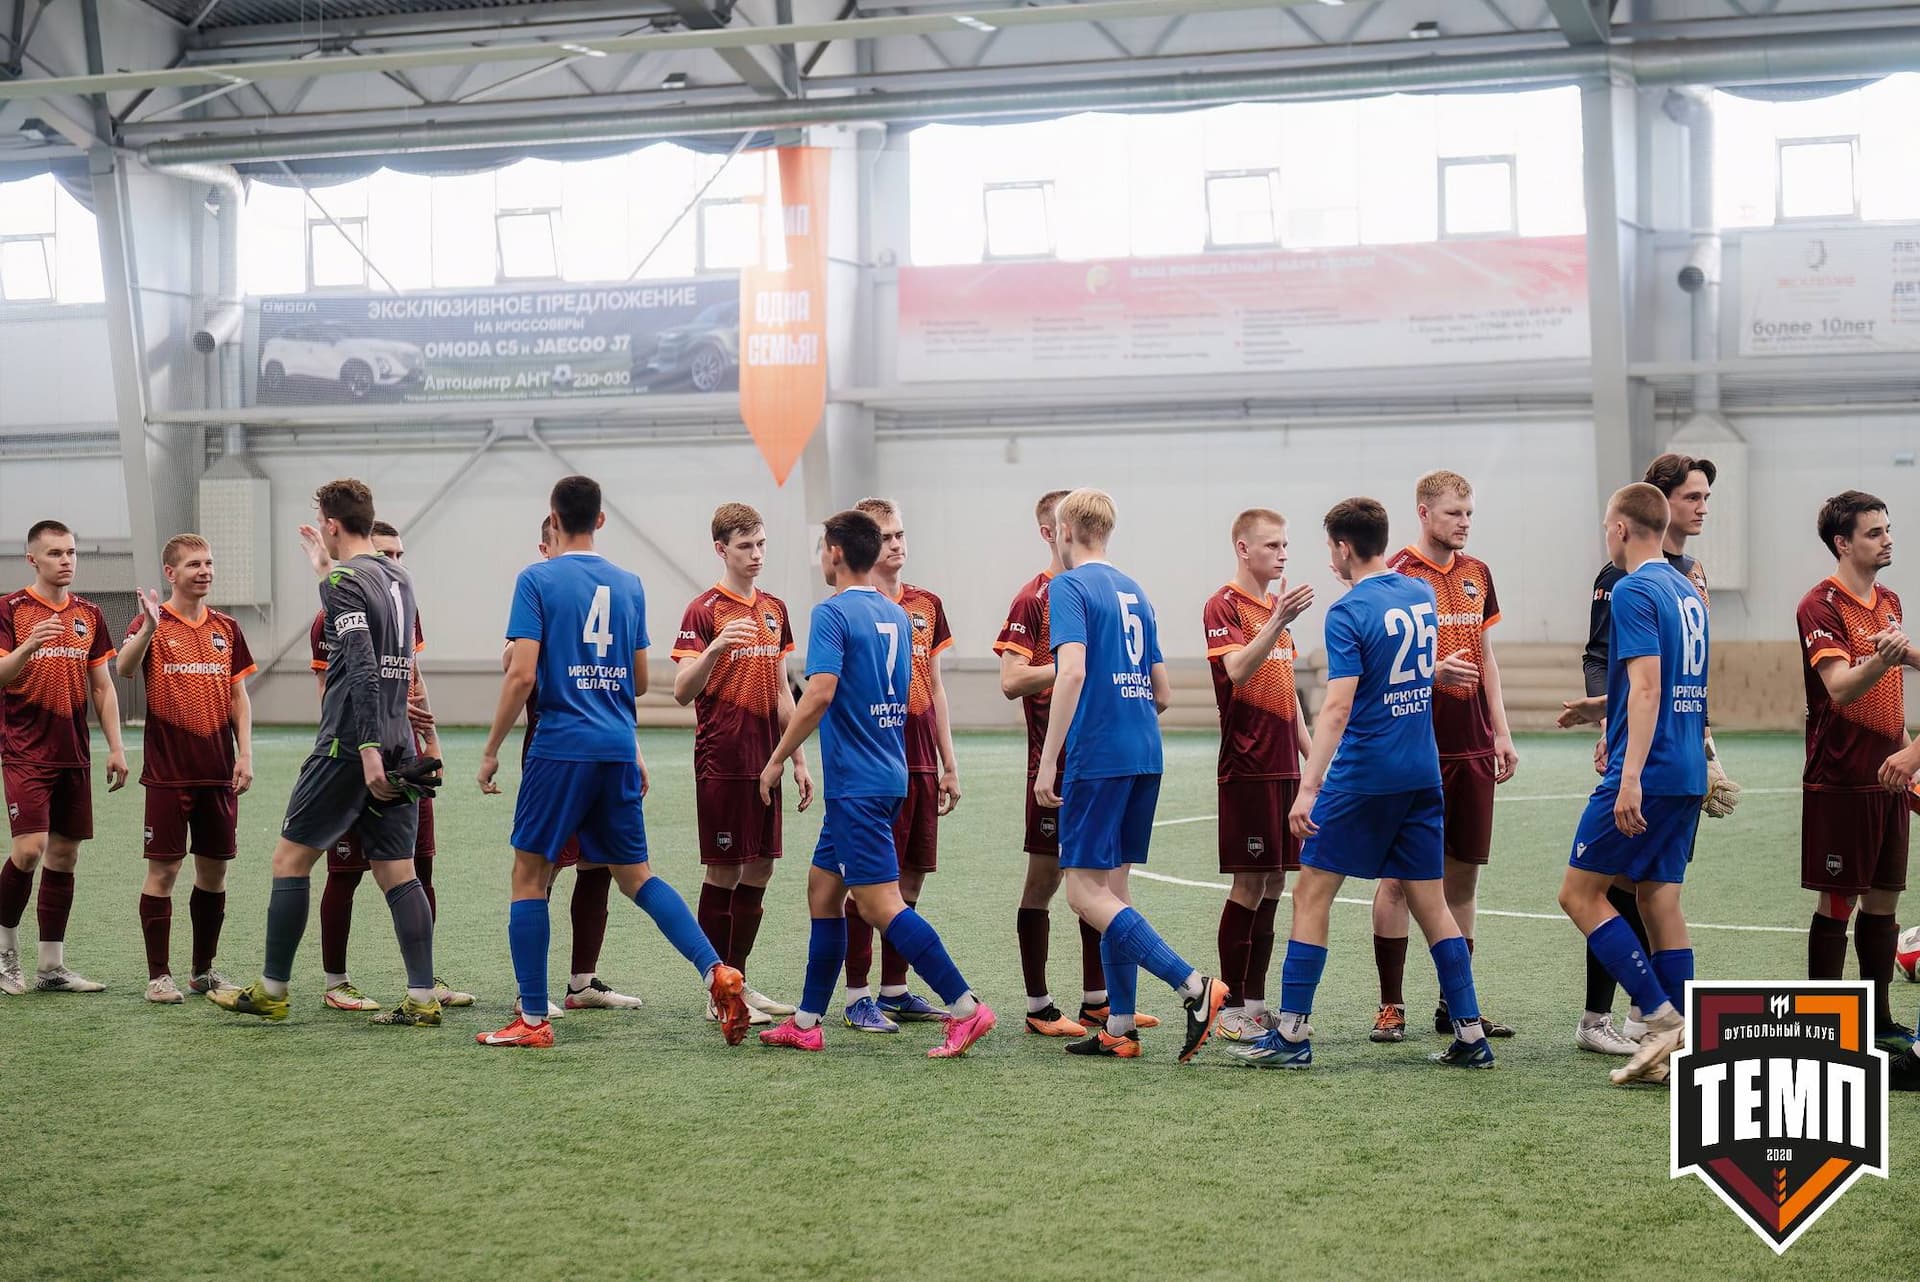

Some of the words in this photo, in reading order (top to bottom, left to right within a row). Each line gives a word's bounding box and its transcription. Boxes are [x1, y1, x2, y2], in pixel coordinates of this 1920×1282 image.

[368, 296, 533, 320] ЭКСКЛЮЗИВНОЕ
[537, 287, 697, 315] ПРЕДЛОЖЕНИЕ
[756, 292, 809, 327] ОДНА
[474, 321, 492, 334] НА
[495, 317, 585, 333] КРОССОВЕРЫ
[1752, 319, 1812, 336] более
[424, 341, 491, 358] OMODA
[495, 339, 518, 356] C5
[521, 345, 530, 356] и
[533, 336, 606, 355] JAECOO
[609, 334, 632, 351] J7
[749, 333, 819, 366] СЕМЬЯ!
[424, 375, 511, 392] Автоцентр
[515, 371, 551, 388] АНТ
[574, 371, 630, 387] 230-030
[335, 615, 368, 633] APTA
[389, 581, 405, 648] 1
[583, 585, 613, 658] 4
[1009, 621, 1027, 635] ПСБ
[1116, 590, 1144, 666] 5
[1208, 627, 1229, 637] ПСБ
[1384, 602, 1438, 685] 25
[1676, 595, 1706, 677] 18
[163, 661, 228, 675] ПРОДИНВЕС
[875, 622, 899, 695] 7
[576, 678, 621, 691] ОБЛАТЬ
